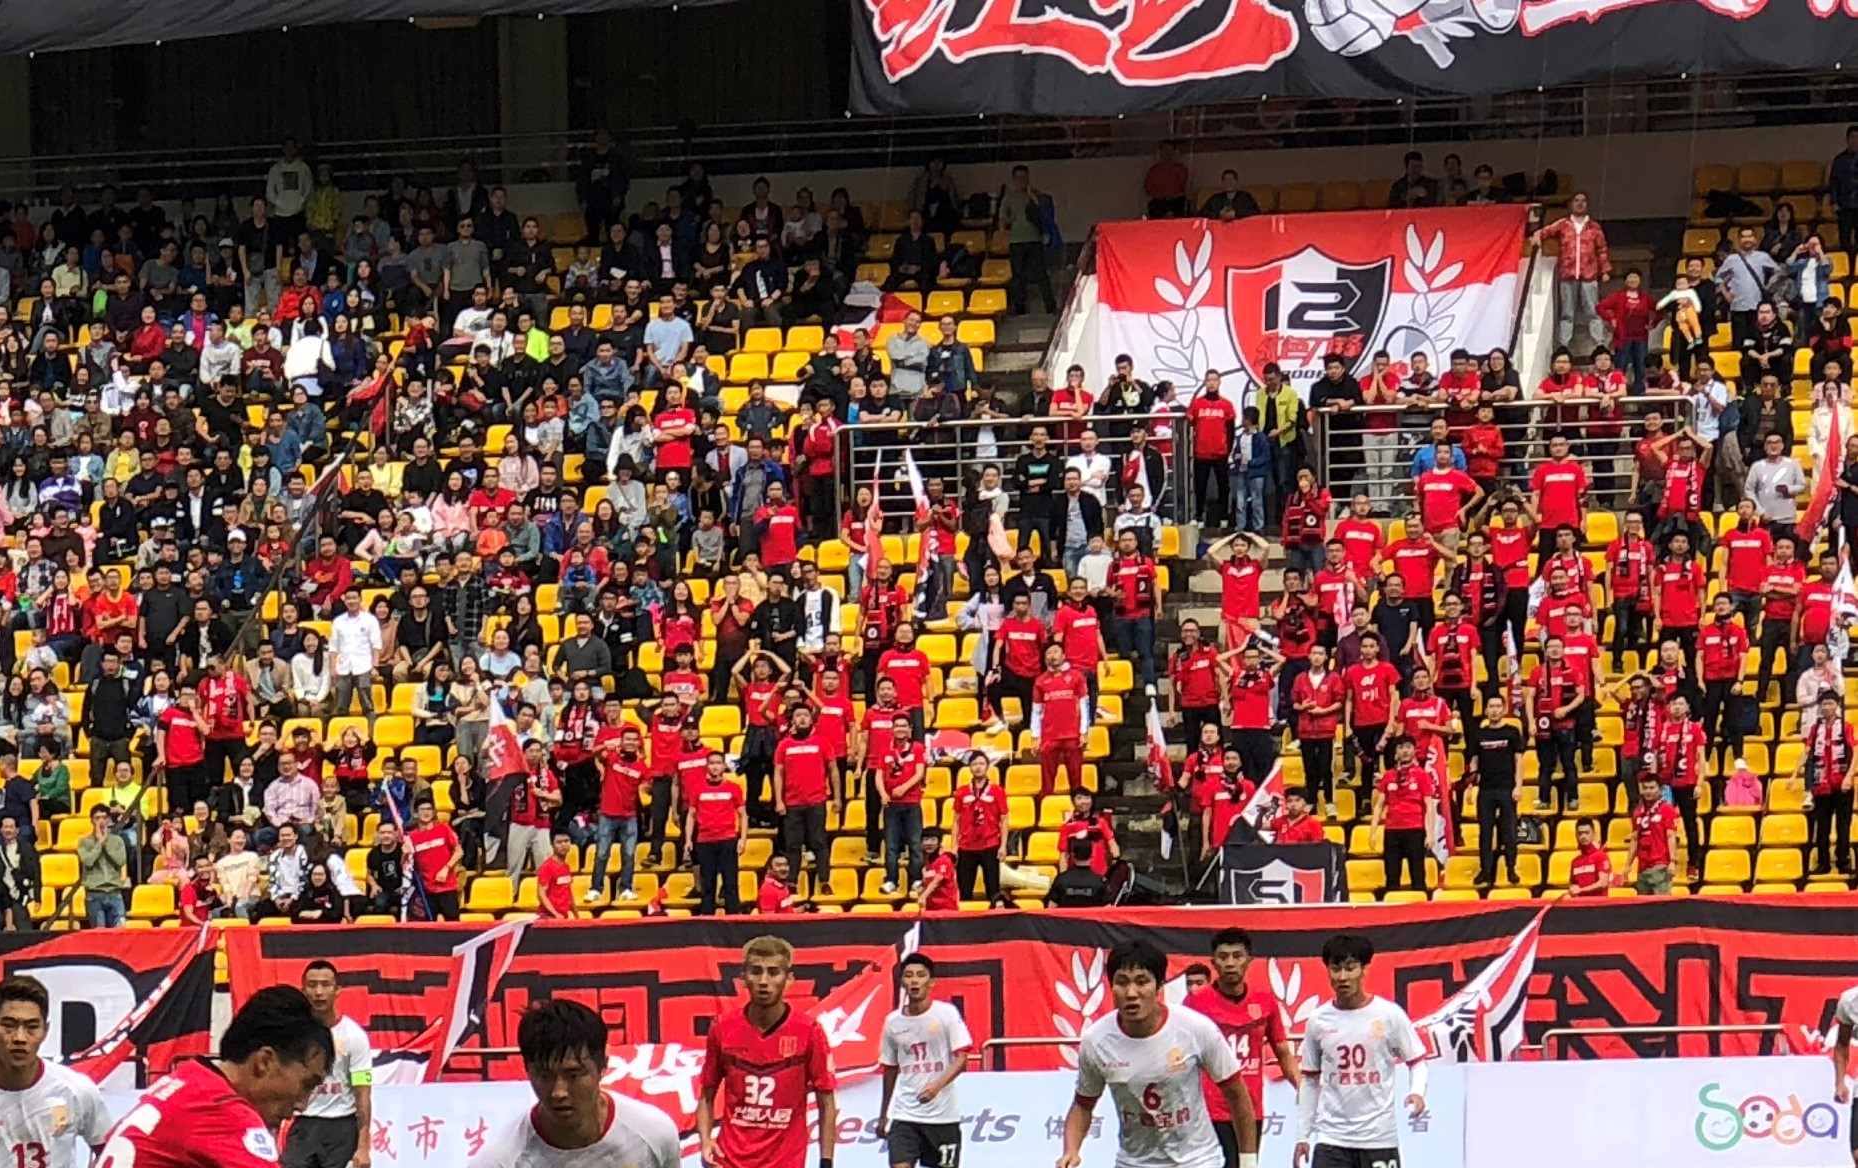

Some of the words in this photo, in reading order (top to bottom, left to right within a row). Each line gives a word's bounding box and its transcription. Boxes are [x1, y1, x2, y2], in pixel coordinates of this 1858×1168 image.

[1262, 278, 1361, 334] 12
[910, 1041, 927, 1061] 17
[1228, 1033, 1250, 1058] 14
[1337, 1044, 1366, 1069] 30
[744, 1075, 776, 1106] 32
[1143, 1082, 1162, 1111] 6
[938, 1144, 957, 1168] 17
